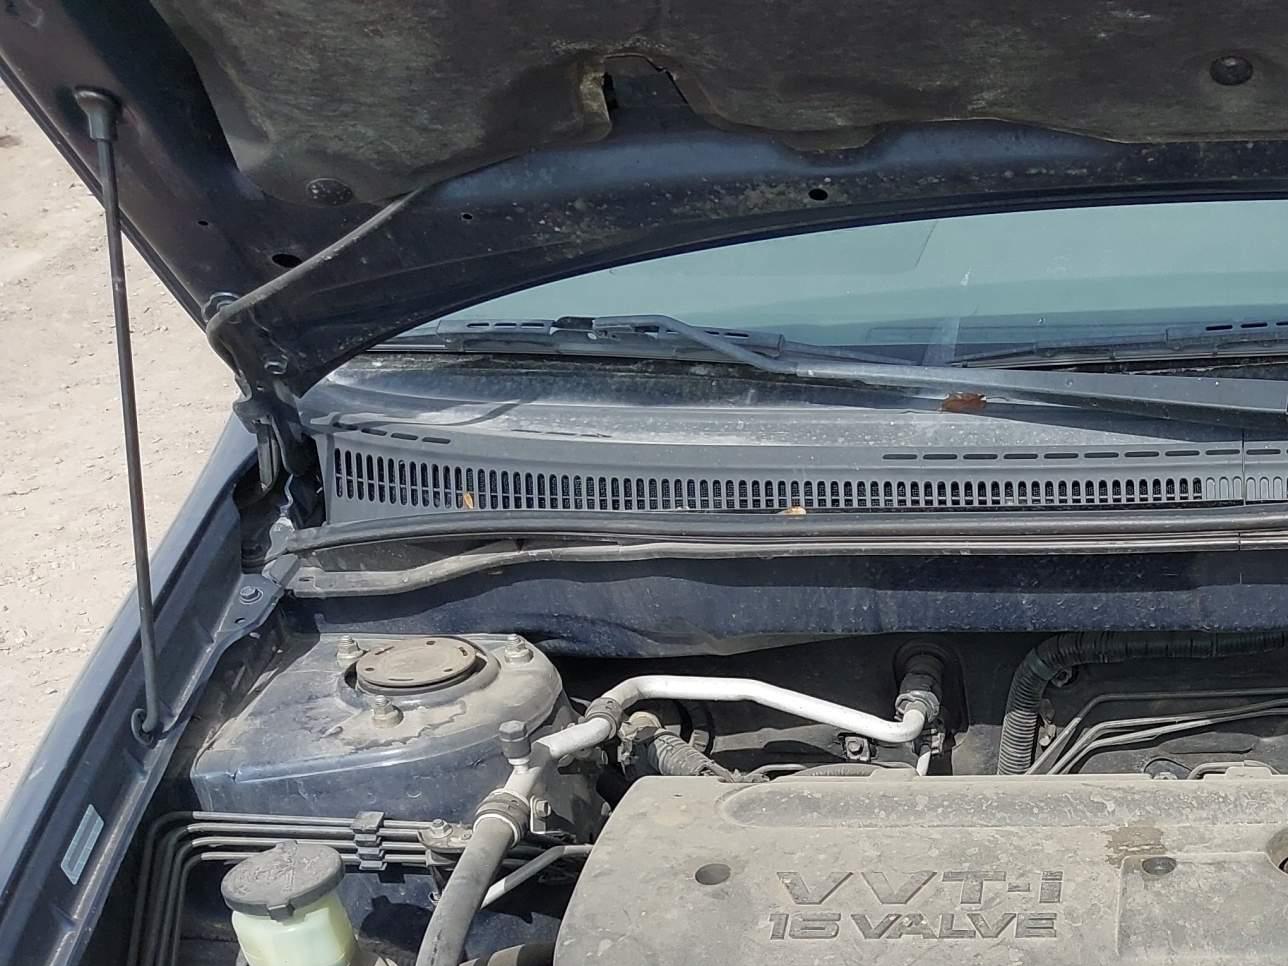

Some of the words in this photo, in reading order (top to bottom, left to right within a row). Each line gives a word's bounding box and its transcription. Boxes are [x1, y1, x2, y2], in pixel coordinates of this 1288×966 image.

[776, 870, 1064, 905] VVT-i
[768, 912, 842, 940] 16
[850, 911, 1057, 940] VALVE
